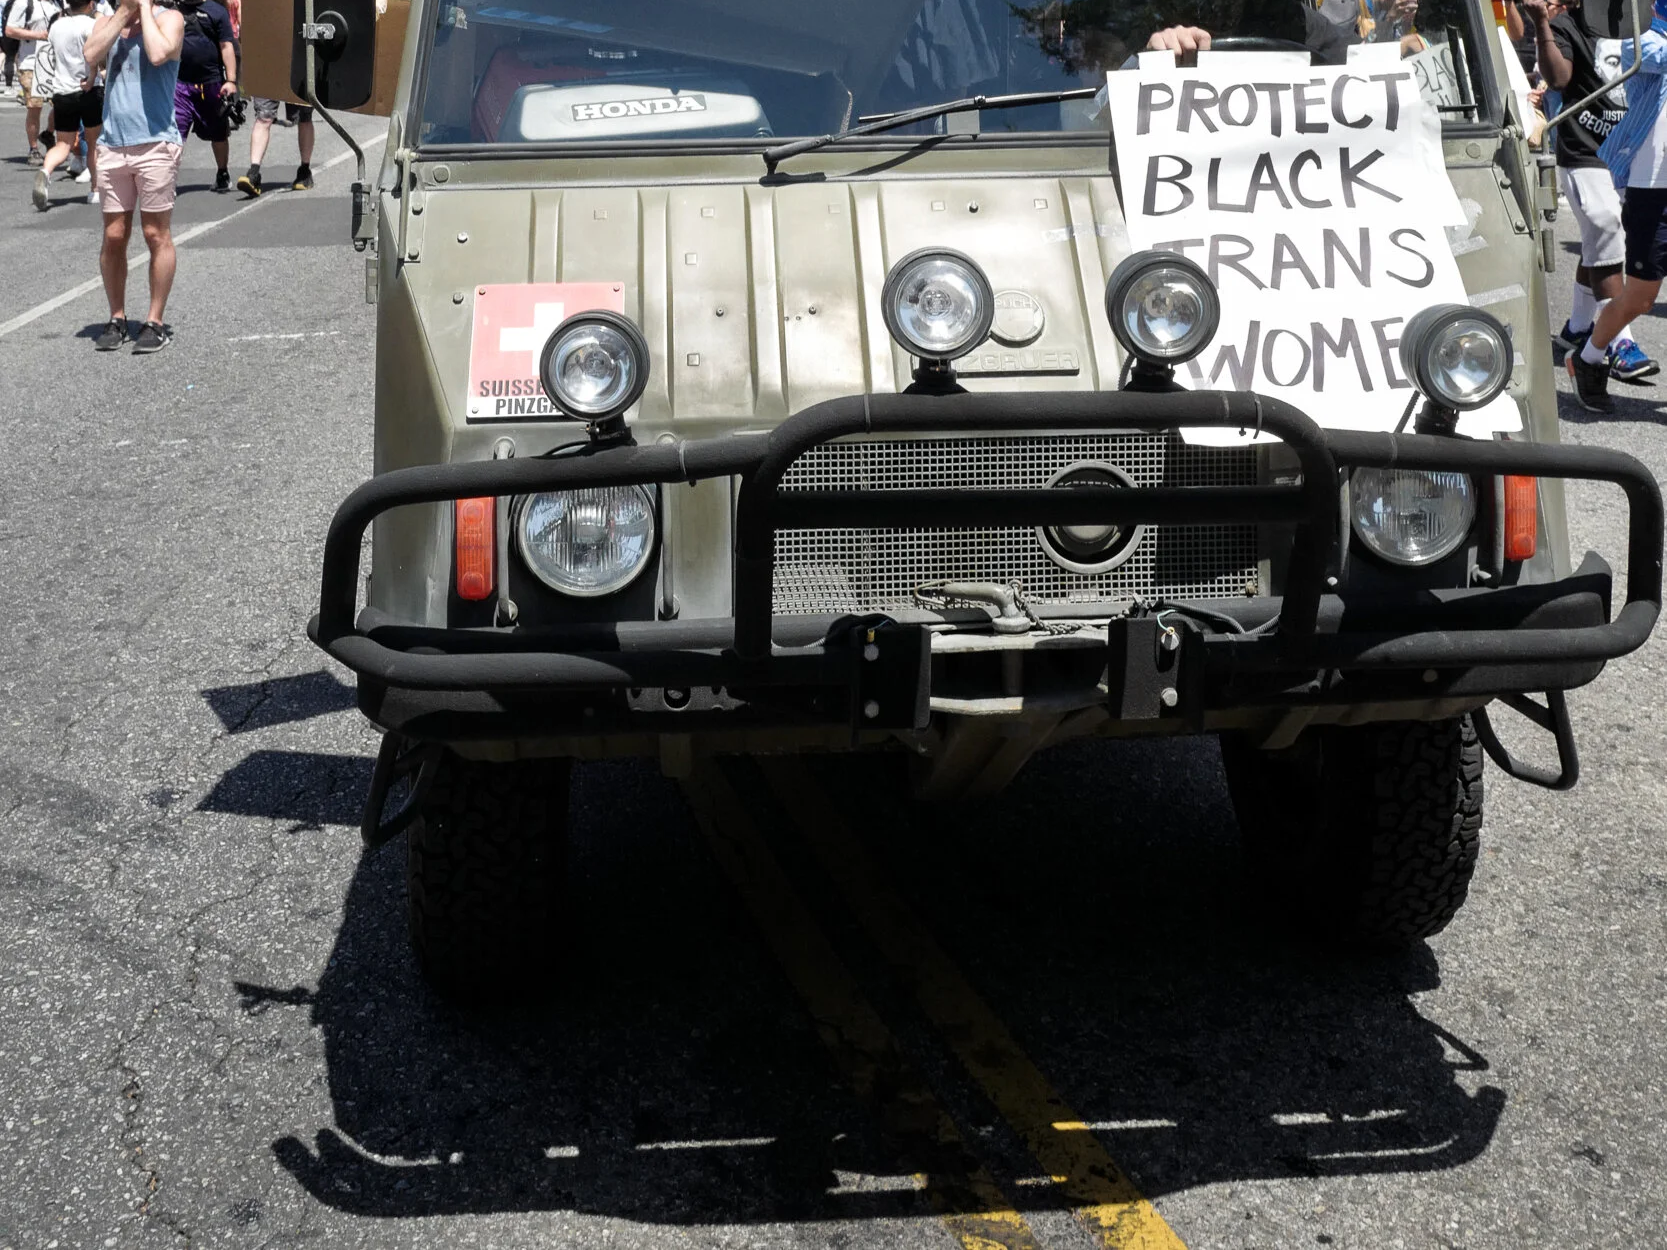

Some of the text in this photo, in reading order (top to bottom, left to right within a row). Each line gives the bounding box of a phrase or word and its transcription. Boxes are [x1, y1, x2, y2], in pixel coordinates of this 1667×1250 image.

[574, 97, 705, 121] HONDA
[1136, 72, 1411, 138] PROTECT
[1142, 147, 1403, 217] BLACK
[1152, 227, 1434, 291] TRANS
[957, 352, 1080, 371] ZGAUER
[1186, 317, 1413, 392] WOME
[480, 379, 544, 398] SUISSE
[495, 397, 562, 416] PINZGA
